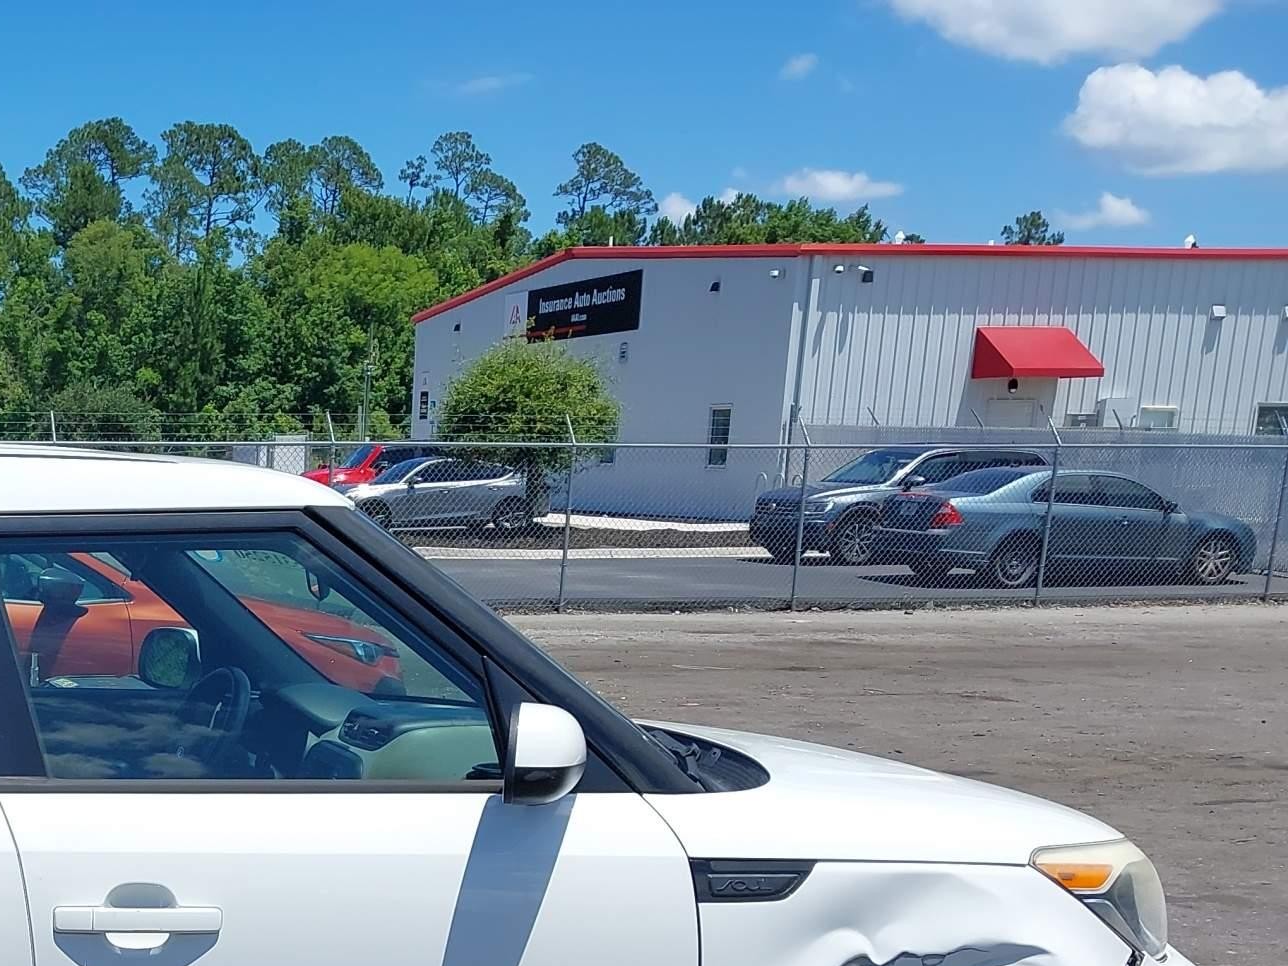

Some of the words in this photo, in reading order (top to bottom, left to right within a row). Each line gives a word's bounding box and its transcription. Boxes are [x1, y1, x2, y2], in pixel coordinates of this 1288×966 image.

[538, 297, 573, 314] Insurance
[573, 291, 591, 308] Auto
[592, 285, 626, 305] Auctions
